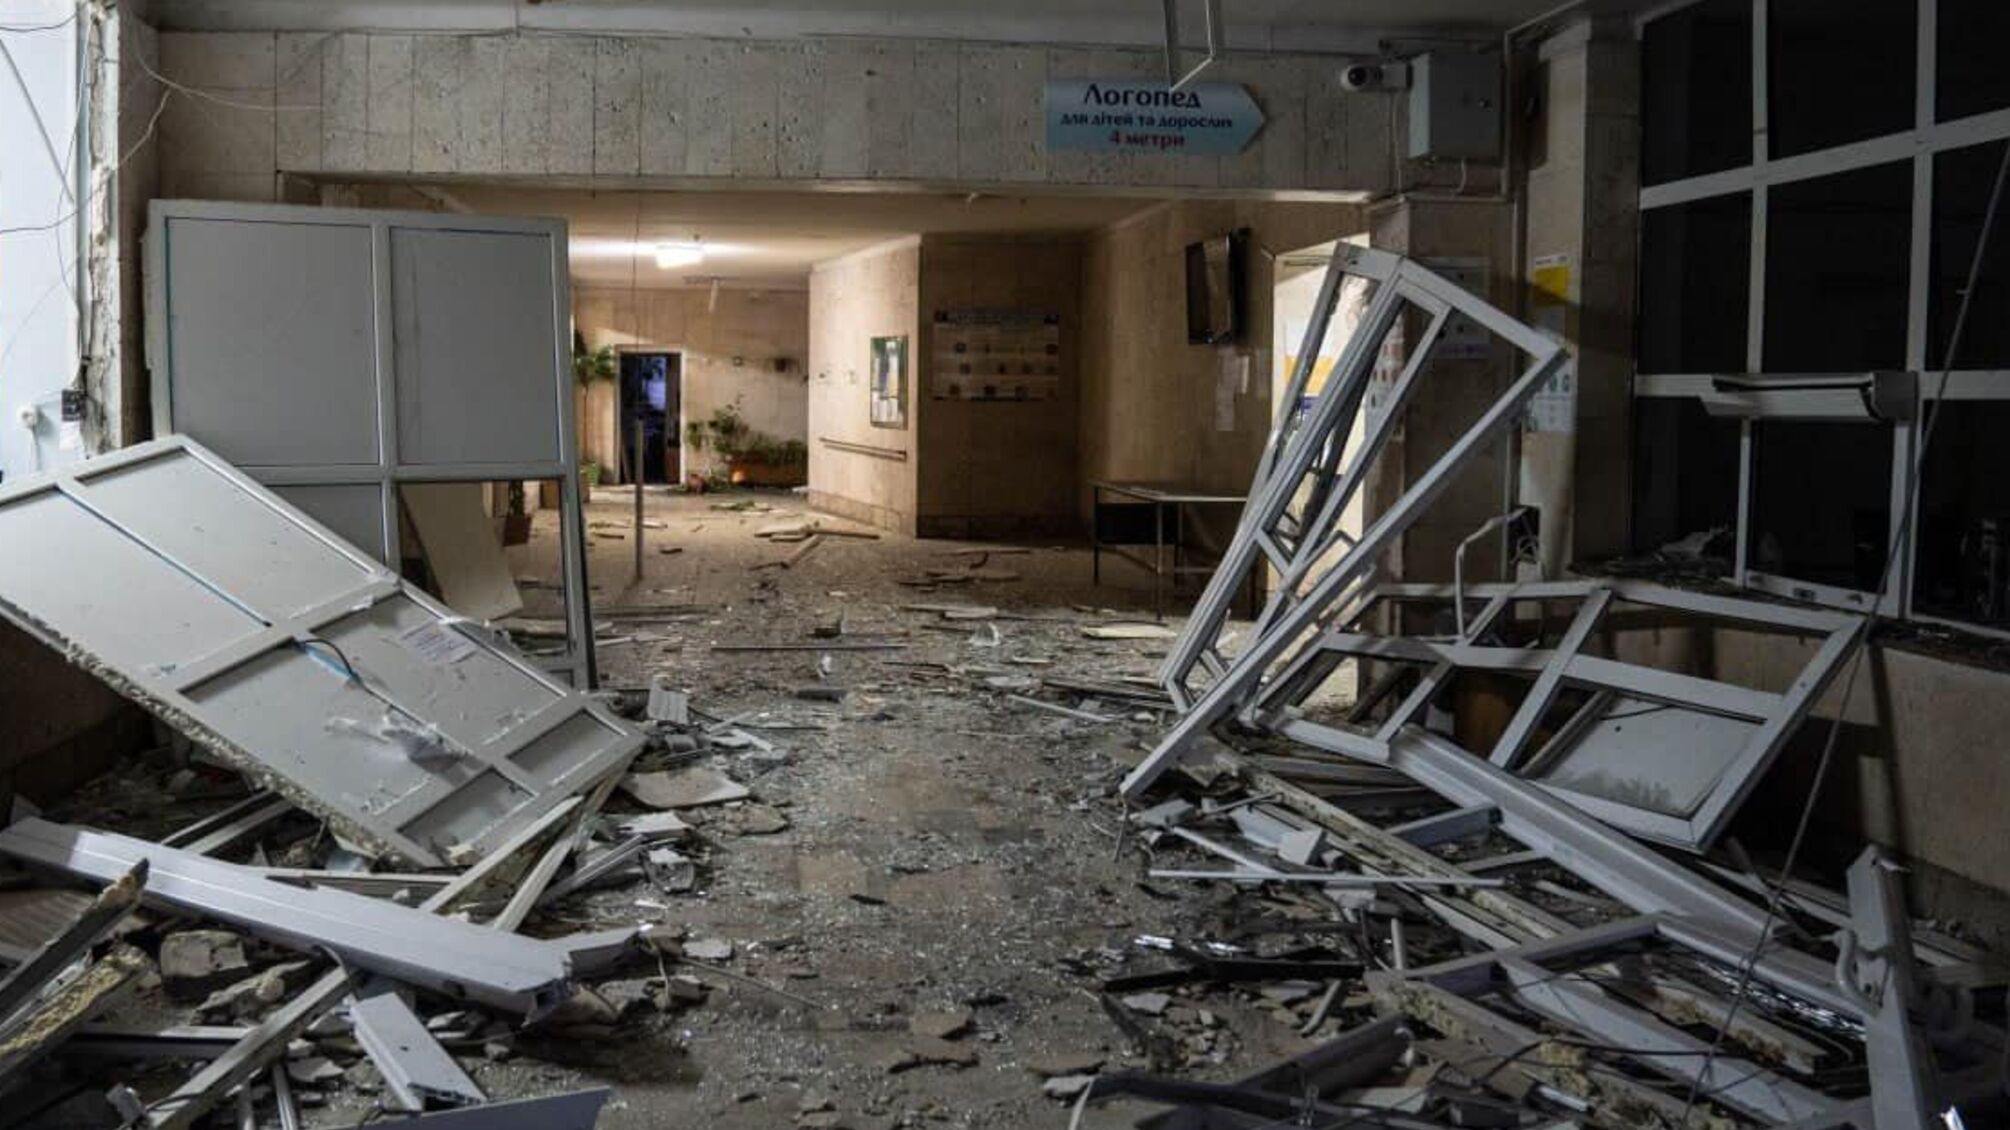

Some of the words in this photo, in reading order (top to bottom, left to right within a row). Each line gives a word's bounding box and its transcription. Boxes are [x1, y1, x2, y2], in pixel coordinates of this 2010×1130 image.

[1083, 83, 1202, 109] Логопед
[1060, 113, 1089, 126] для
[1091, 111, 1134, 127] дітей
[1138, 115, 1156, 127] та
[1109, 130, 1120, 146] 4
[1125, 133, 1186, 150] метри
